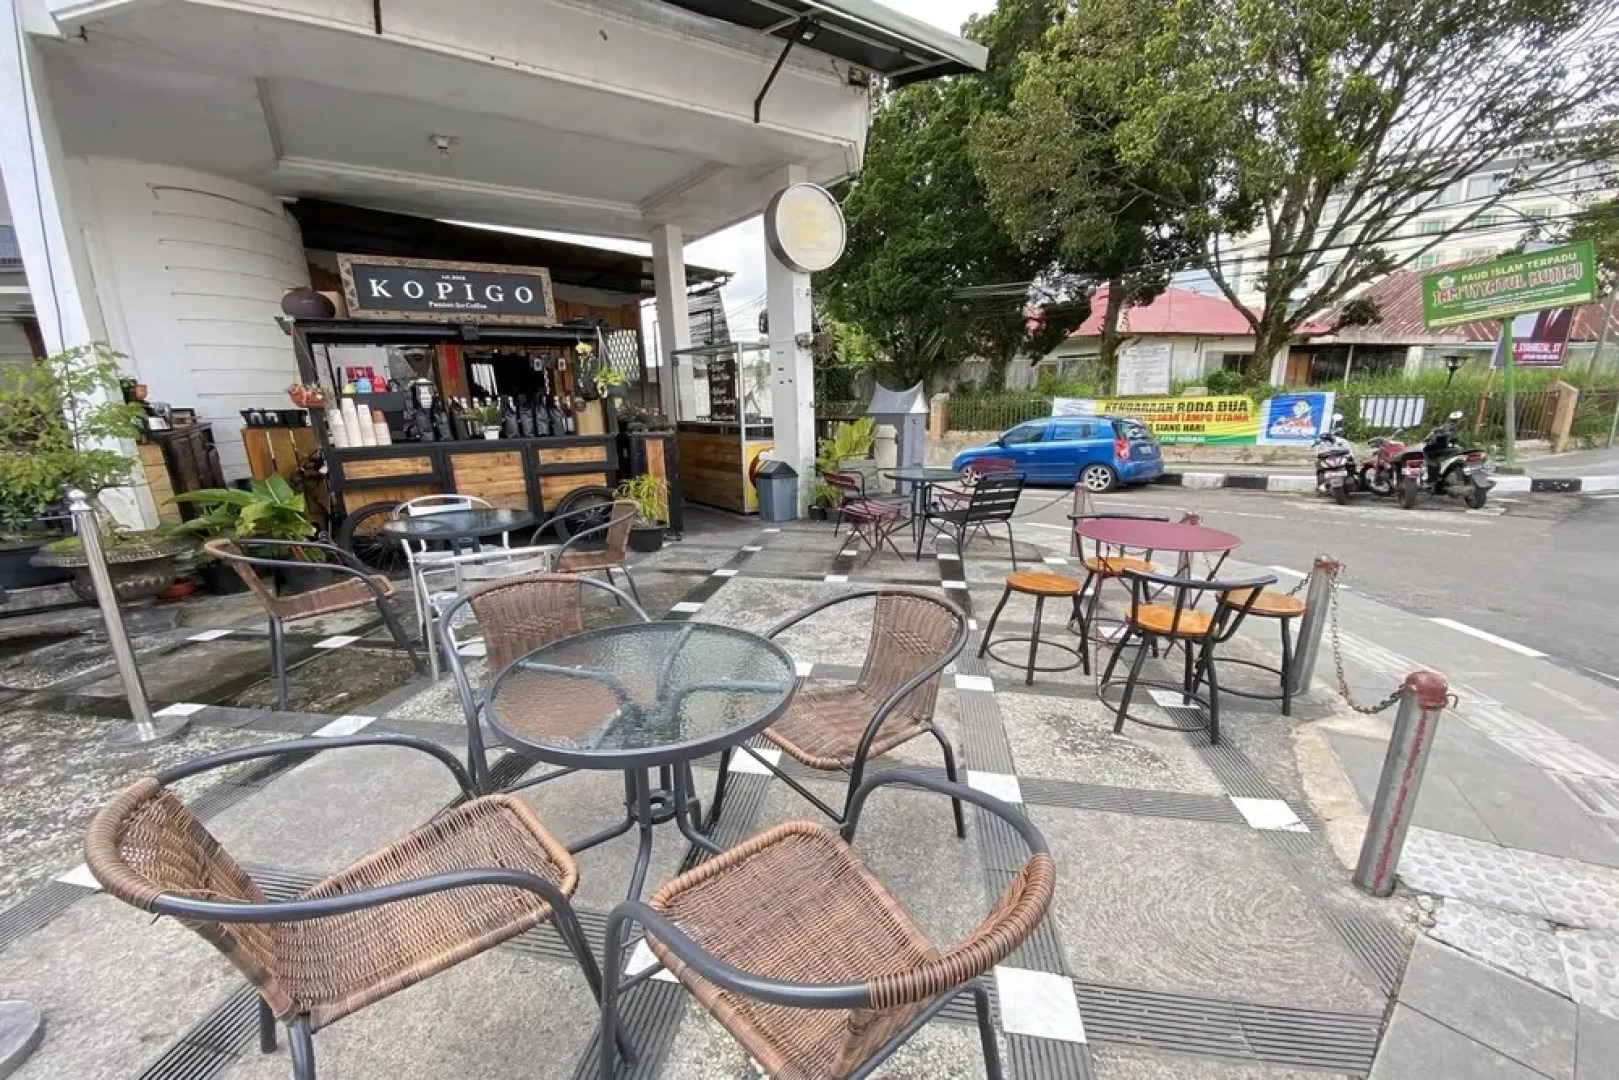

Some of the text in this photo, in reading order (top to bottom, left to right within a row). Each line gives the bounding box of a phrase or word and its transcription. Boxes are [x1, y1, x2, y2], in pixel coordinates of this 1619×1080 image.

[1490, 263, 1524, 278] ISLAM
[1525, 252, 1577, 270] TERPADU
[368, 278, 534, 304] KOPIGO
[1176, 401, 1215, 413] RODA
[1217, 400, 1248, 412] DUA
[1214, 413, 1249, 422] UTAMA
[1155, 423, 1181, 432] SIANG
[1183, 423, 1205, 432] HARI
